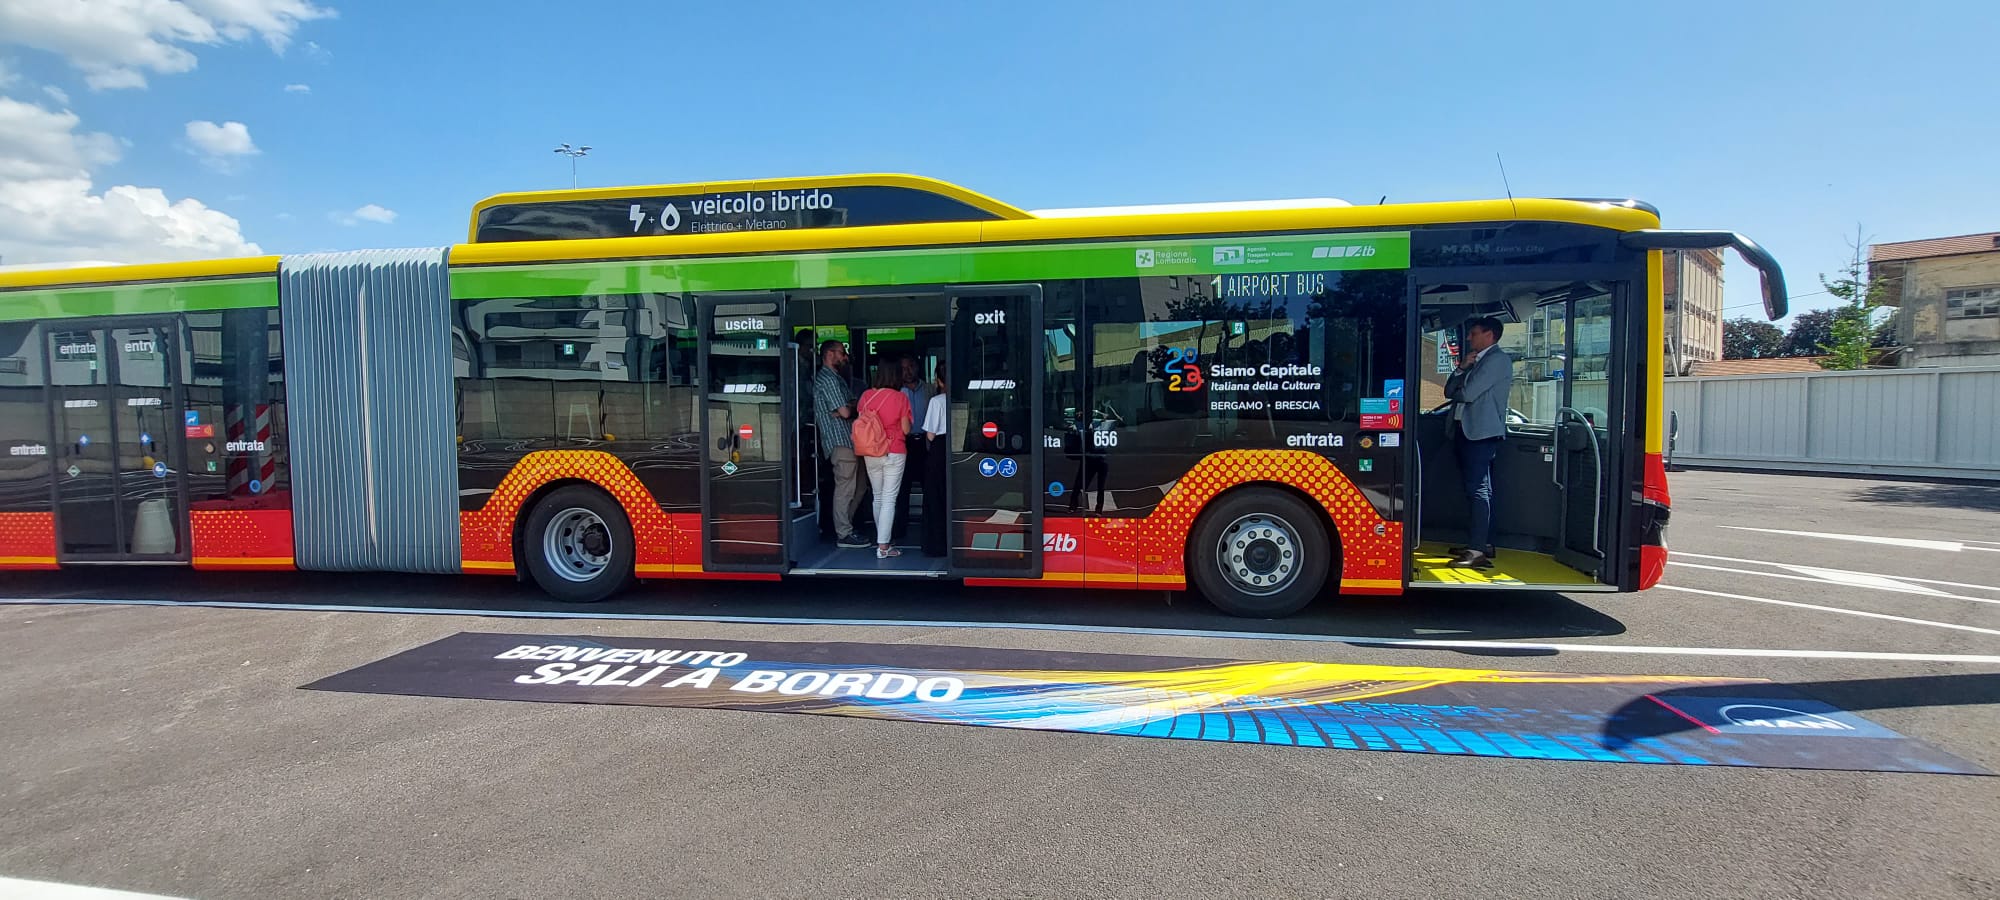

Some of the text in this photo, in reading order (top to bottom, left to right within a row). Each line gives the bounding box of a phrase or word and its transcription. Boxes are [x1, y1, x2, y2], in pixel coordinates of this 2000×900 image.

[691, 189, 833, 215] veicolo ibrido
[691, 221, 734, 233] Elettrico
[745, 218, 787, 230] Metano
[1155, 250, 1188, 259] Regione
[1155, 256, 1197, 265] Lombardia
[1210, 273, 1324, 299] 1 AIRPORT BUS
[974, 309, 1006, 325] exit
[725, 318, 764, 331] uscita
[60, 342, 97, 354] entrata
[124, 340, 156, 353] entry
[1210, 363, 1321, 378] Siamo Capitale
[1210, 380, 1321, 391] Italiana della Cultura
[1210, 400, 1320, 410] BERGAMO BRESCIA
[1043, 434, 1061, 448] ita
[1093, 430, 1118, 447] 656
[1286, 433, 1343, 447] entrata
[10, 444, 47, 455] entrata
[226, 440, 264, 452] entrata
[493, 645, 748, 667] BENVENUTO
[514, 662, 965, 702] SALI A BORDO
[1735, 718, 1846, 730] MAN
